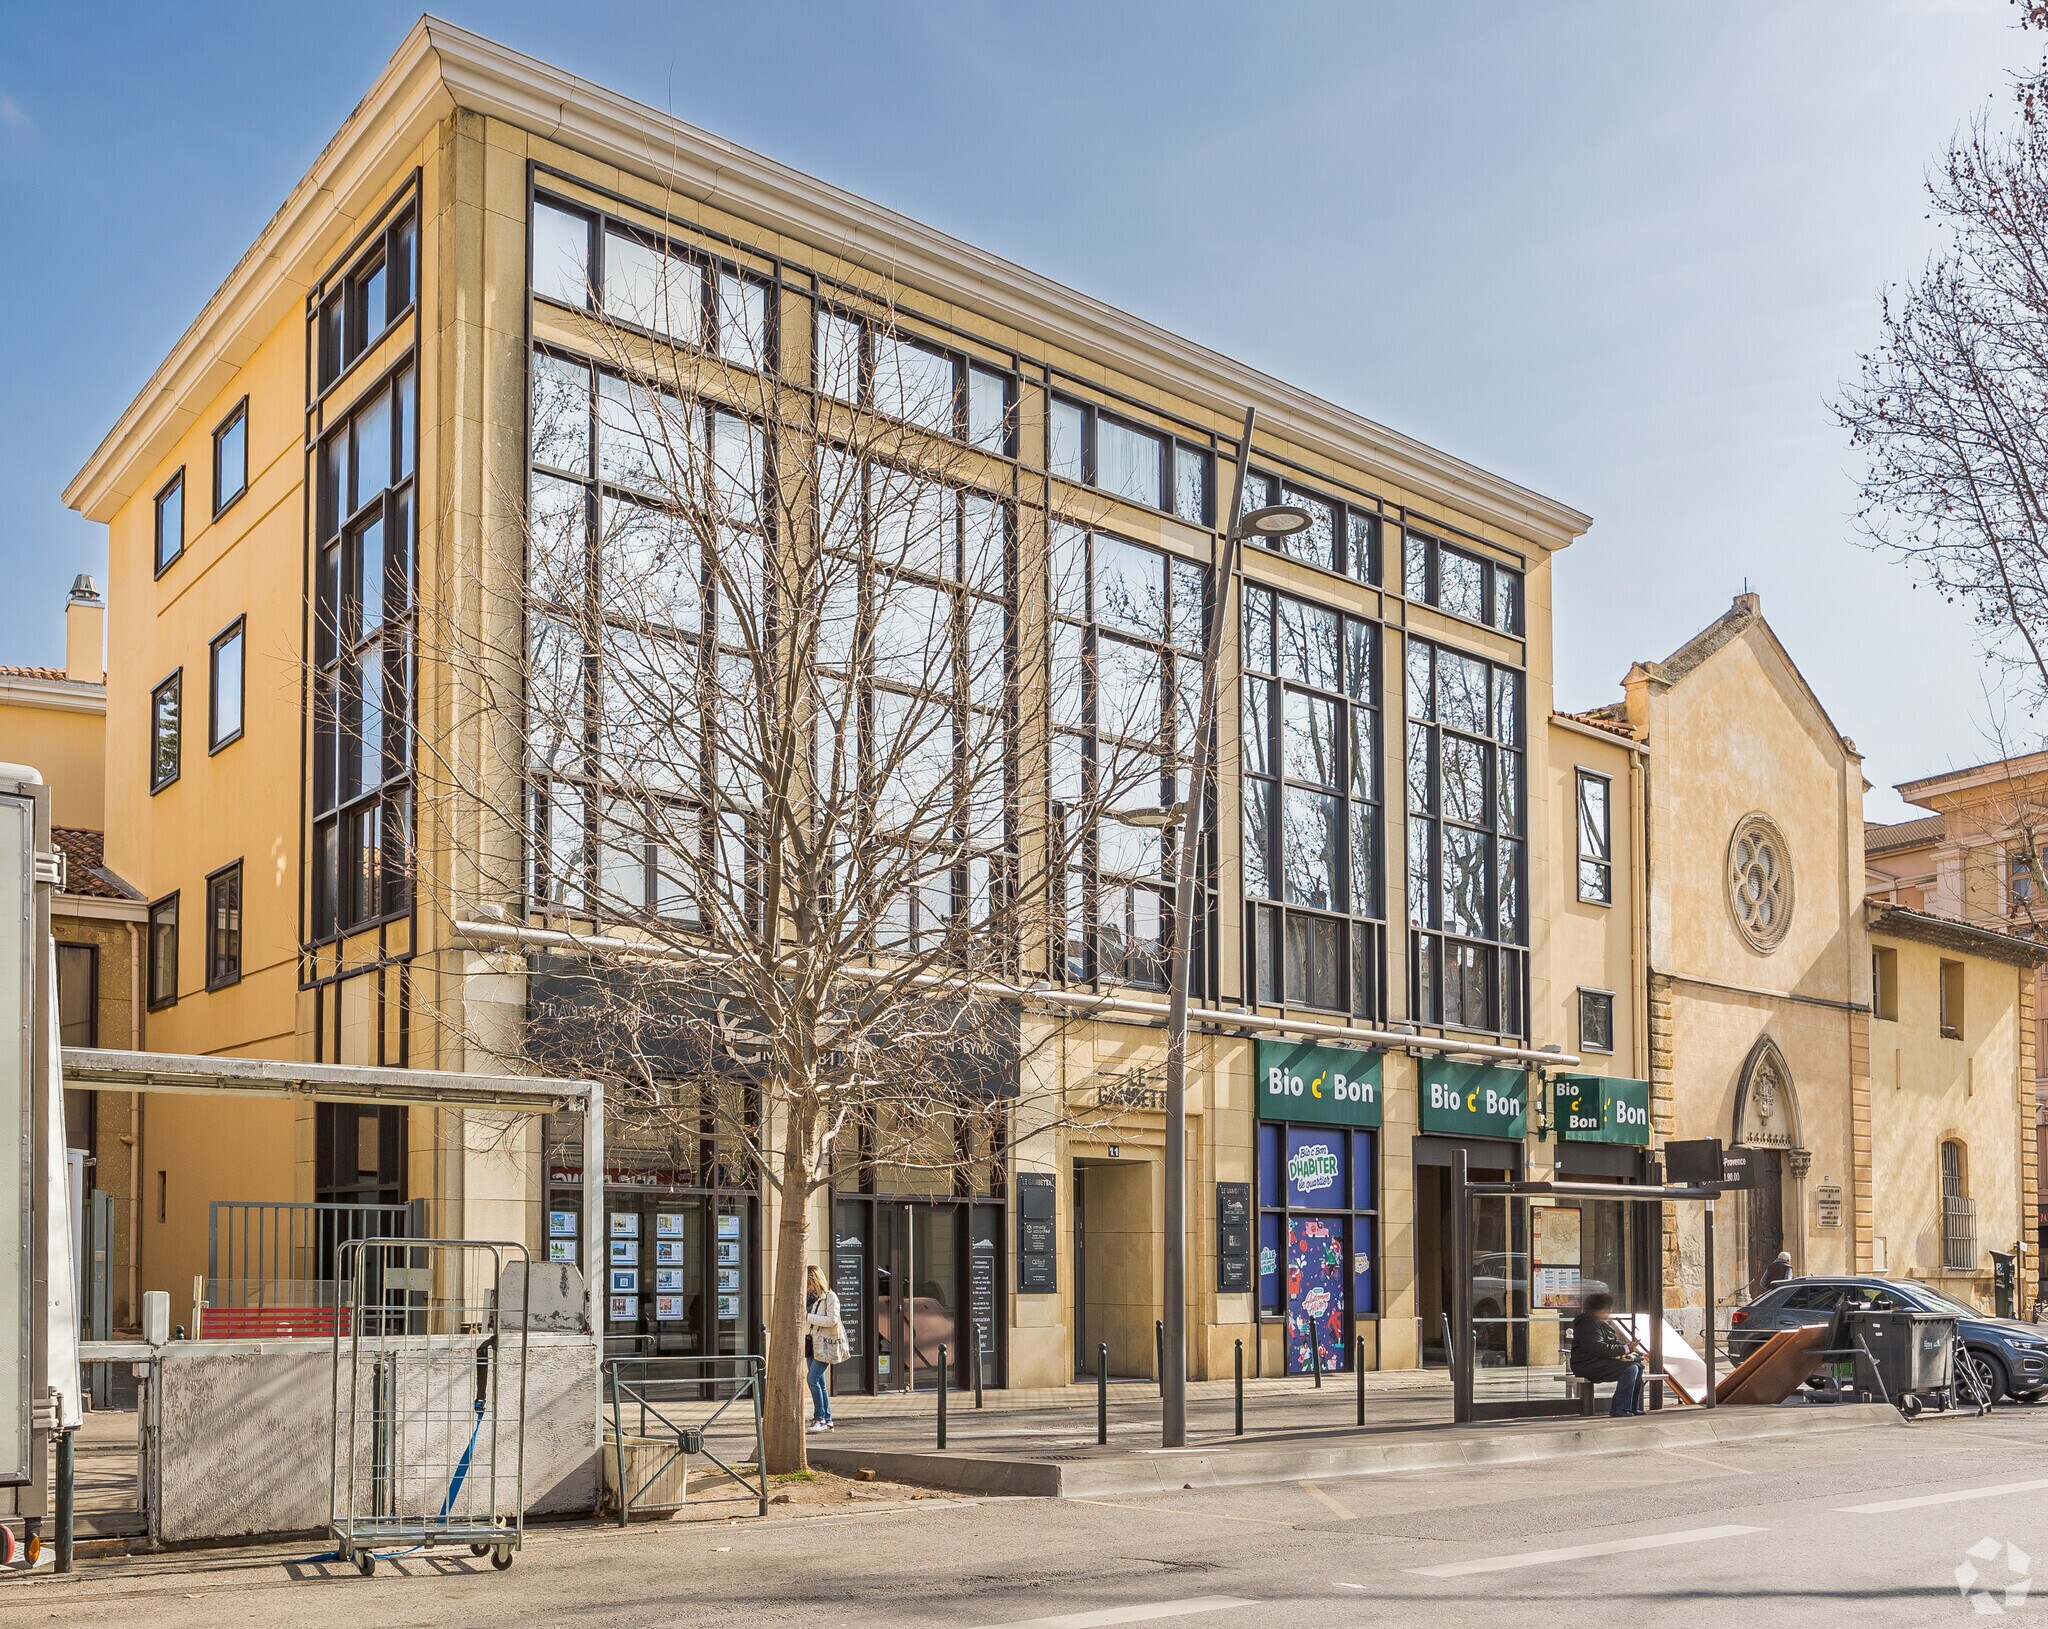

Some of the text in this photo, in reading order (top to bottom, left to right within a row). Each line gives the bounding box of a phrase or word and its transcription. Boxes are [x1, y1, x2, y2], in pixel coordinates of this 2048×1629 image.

[1269, 1067, 1304, 1097] Bio
[1334, 1074, 1374, 1103] Bon
[1556, 1083, 1580, 1096] Bio
[1098, 1086, 1167, 1108] GAMBETT
[1431, 1084, 1461, 1110] Bio
[1486, 1089, 1520, 1117] Bon
[1569, 1115, 1597, 1128] Bon
[1616, 1100, 1646, 1125] Bon
[1109, 1146, 1119, 1156] 11
[1289, 1156, 1337, 1179] D'HABITER
